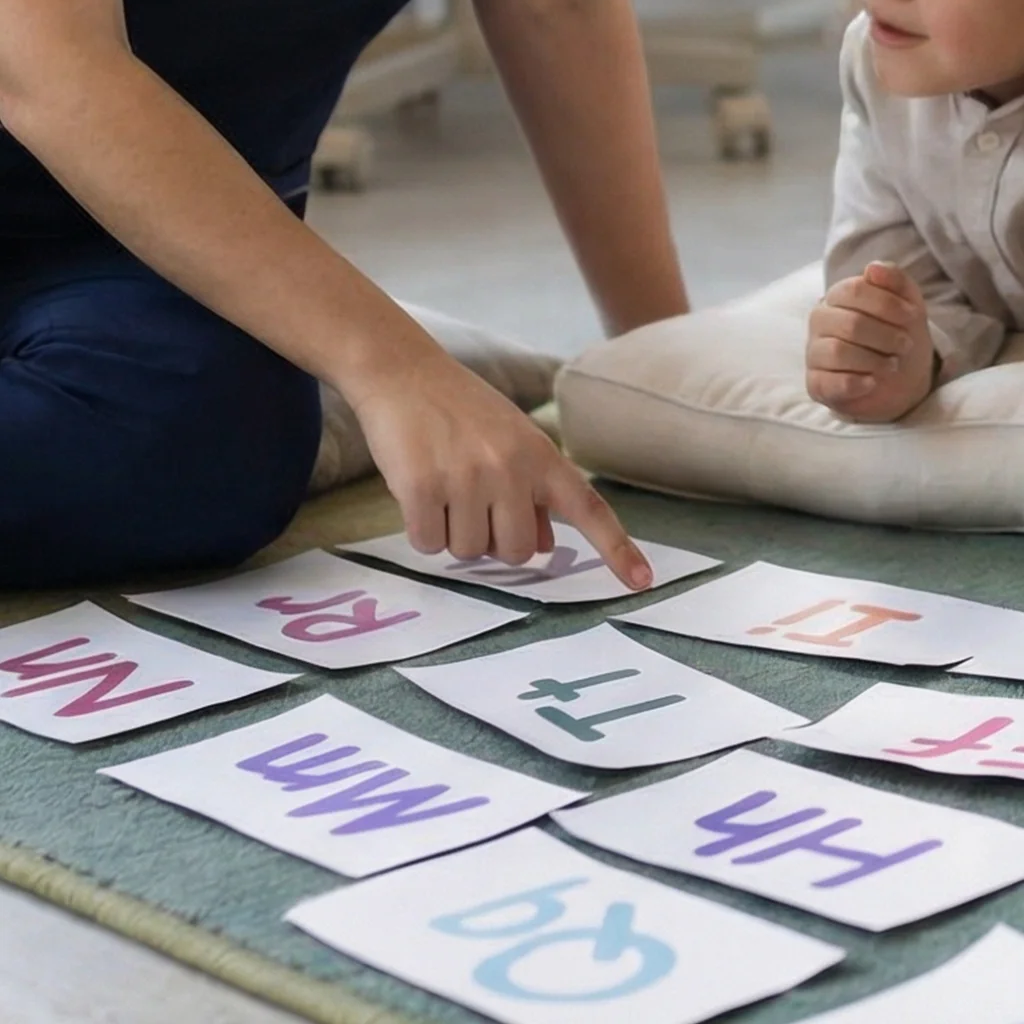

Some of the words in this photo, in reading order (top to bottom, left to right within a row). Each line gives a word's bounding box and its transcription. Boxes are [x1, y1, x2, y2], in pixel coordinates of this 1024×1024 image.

[256, 589, 420, 642] Rr
[747, 598, 922, 648] Ii
[0, 637, 195, 717] Nn
[517, 668, 686, 742] Tt
[236, 733, 490, 836] Mm
[694, 790, 944, 889] Hh
[429, 876, 678, 1003] Qq
